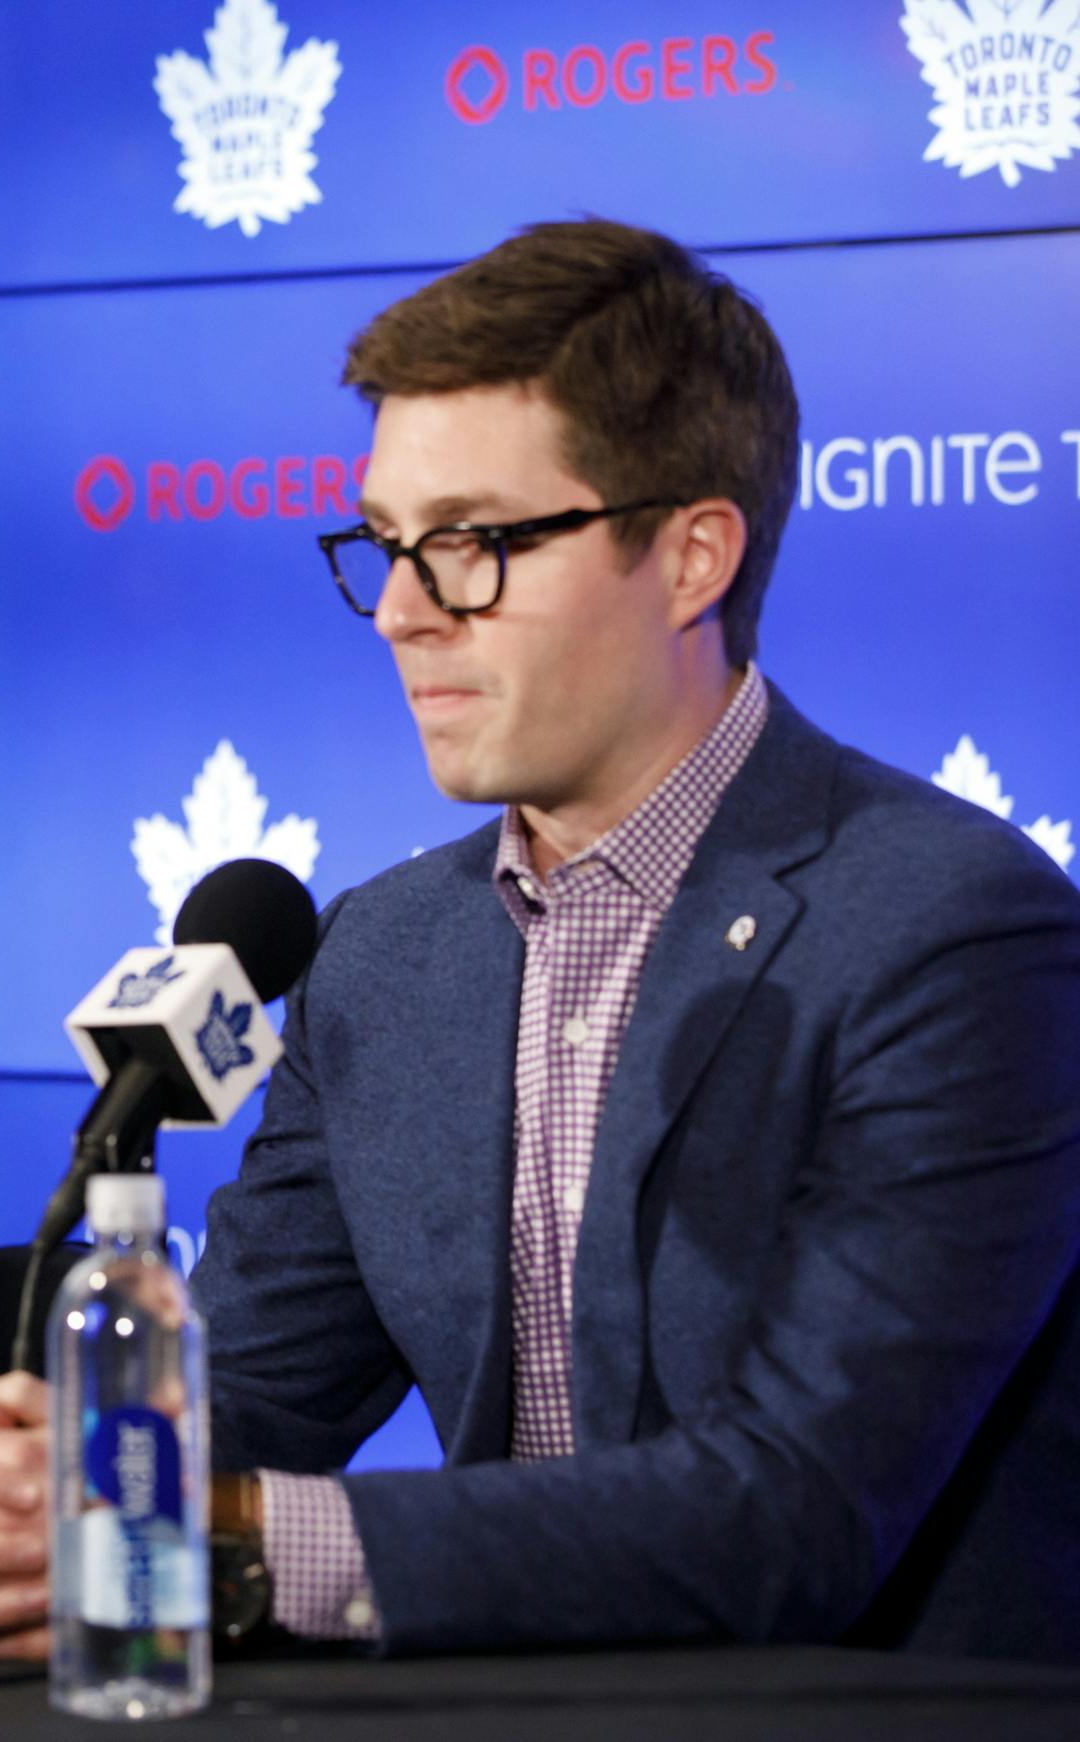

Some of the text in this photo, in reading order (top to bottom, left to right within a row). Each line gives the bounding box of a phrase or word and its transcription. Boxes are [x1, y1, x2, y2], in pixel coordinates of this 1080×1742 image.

[523, 32, 777, 111] ROGERS
[943, 30, 1072, 77] TORONTO
[965, 70, 1049, 98] MAPLE
[964, 102, 1050, 131] LEAFS
